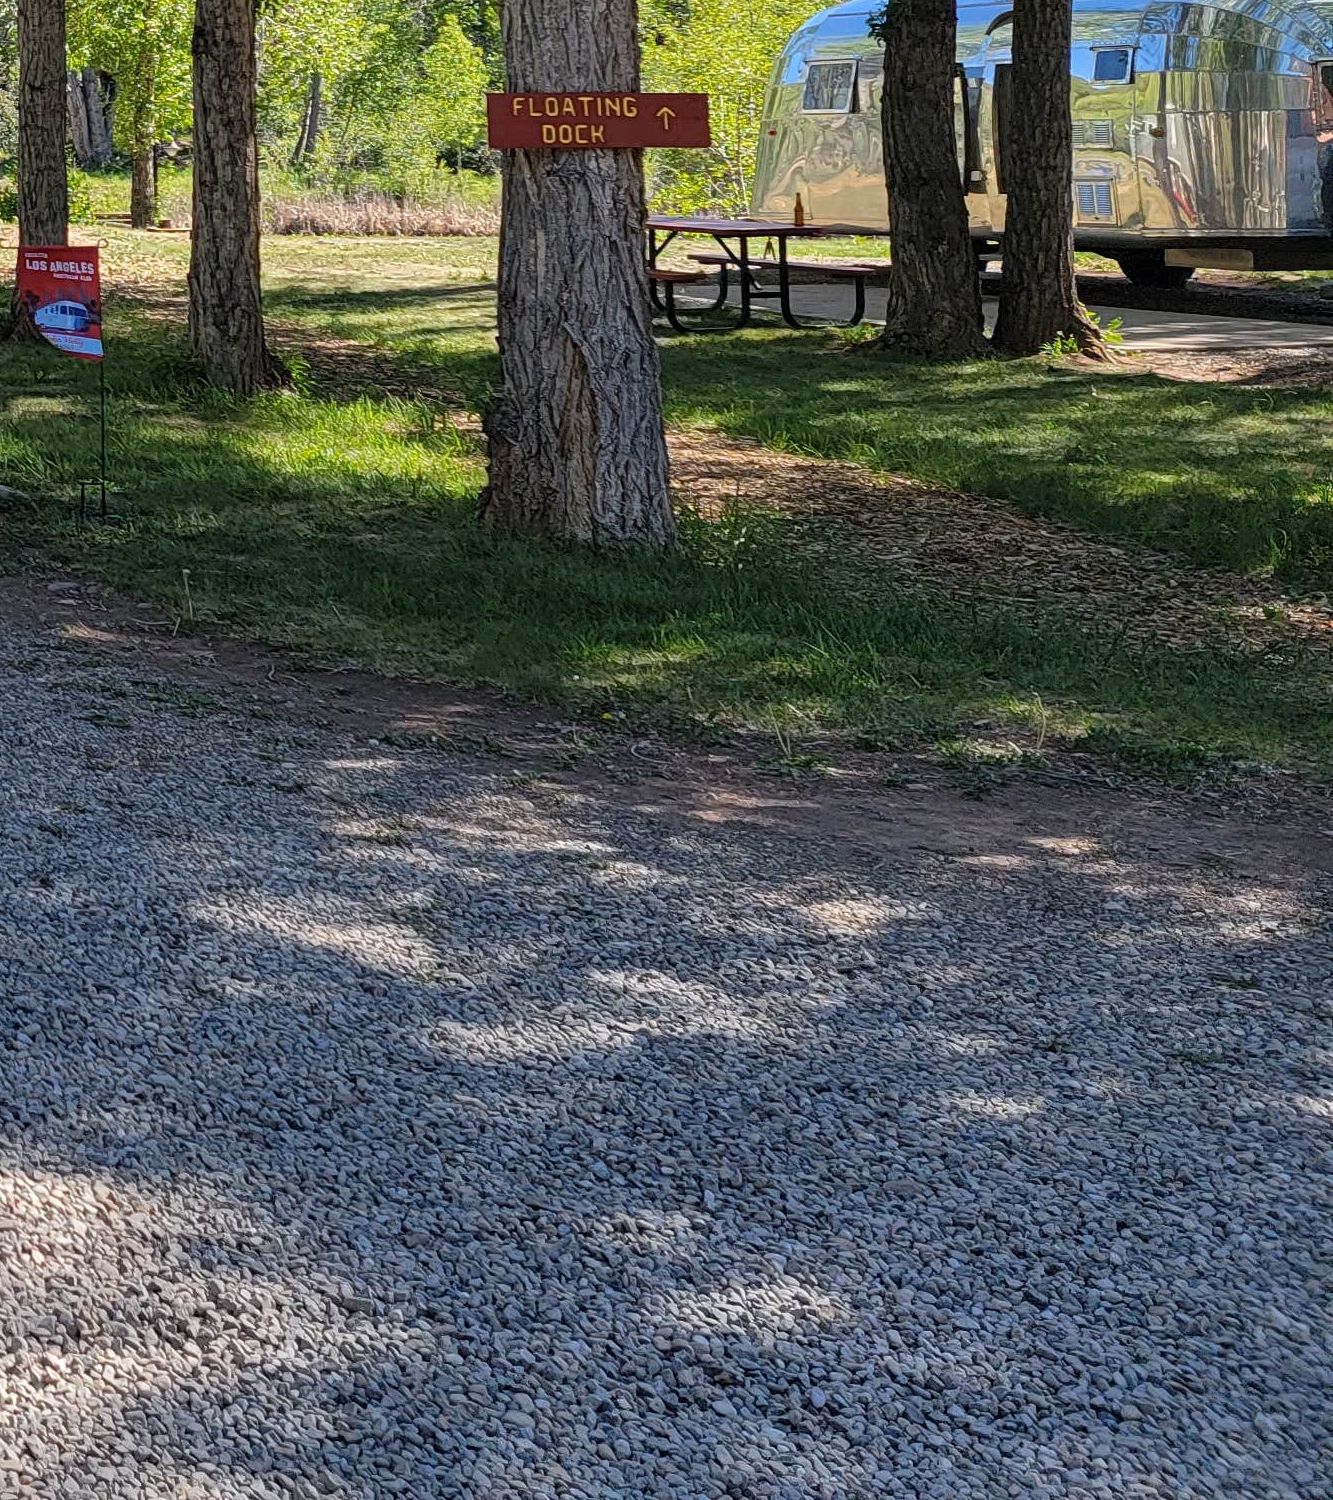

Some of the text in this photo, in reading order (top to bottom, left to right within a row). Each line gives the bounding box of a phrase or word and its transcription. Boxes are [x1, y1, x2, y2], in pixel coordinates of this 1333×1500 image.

[512, 97, 638, 118] FLOATING
[542, 124, 605, 144] DOCK
[25, 259, 95, 275] LOS ANGELES
